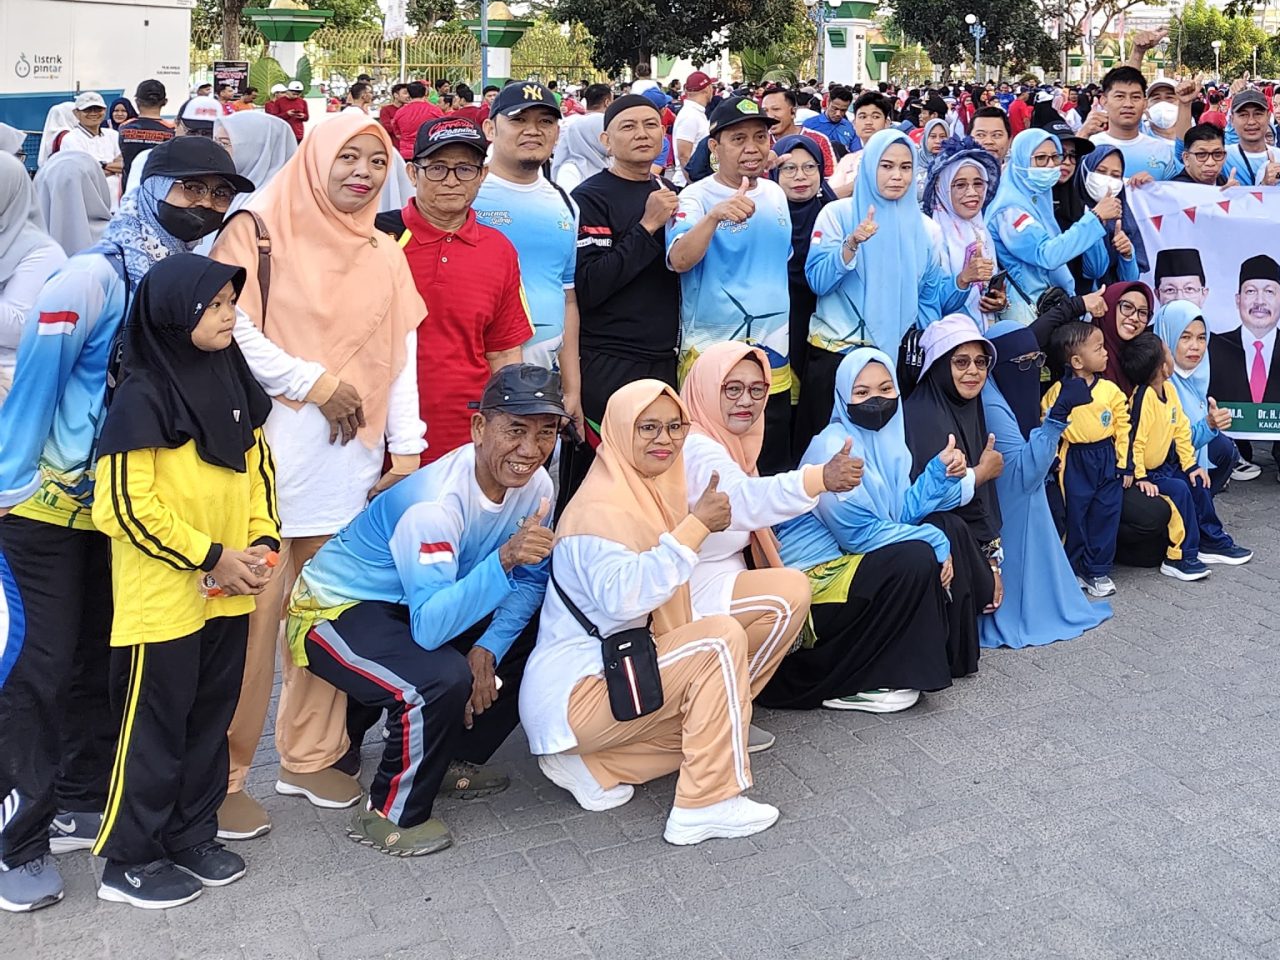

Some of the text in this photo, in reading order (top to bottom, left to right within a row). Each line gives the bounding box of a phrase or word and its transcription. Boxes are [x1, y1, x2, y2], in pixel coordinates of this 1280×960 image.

[34, 54, 62, 64] listrik
[33, 64, 62, 74] pintar
[522, 84, 543, 100] NY
[1258, 409, 1267, 419] Dr.
[1270, 410, 1277, 419] H.
